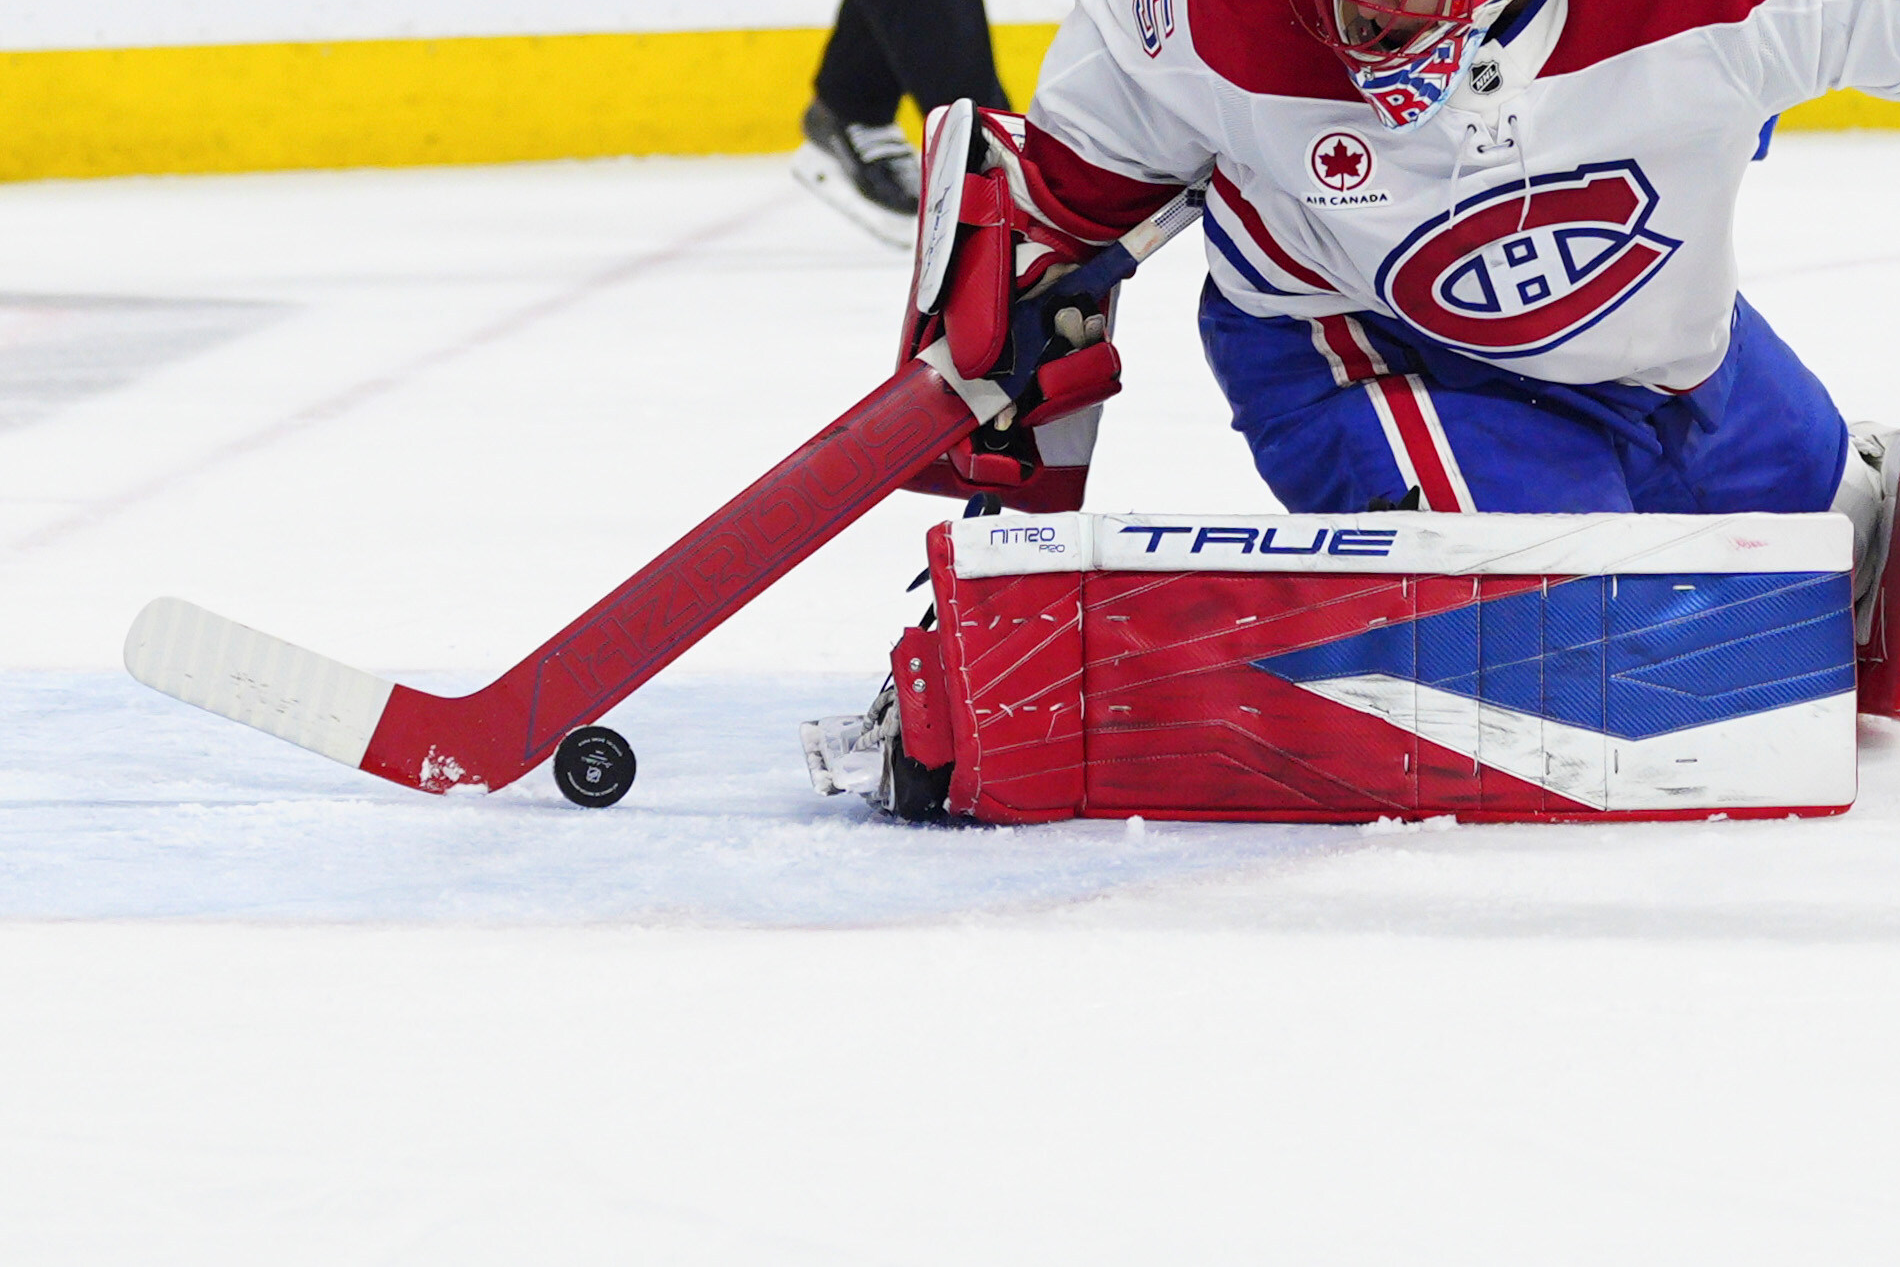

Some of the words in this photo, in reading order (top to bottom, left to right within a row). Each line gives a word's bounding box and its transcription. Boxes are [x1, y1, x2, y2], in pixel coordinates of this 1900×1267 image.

[1475, 67, 1497, 90] NHL
[1306, 196, 1327, 206] AIR
[1330, 193, 1388, 205] CANADA
[989, 527, 1056, 545] NITRO
[1119, 525, 1398, 557] TRUE
[1039, 544, 1066, 554] PRO
